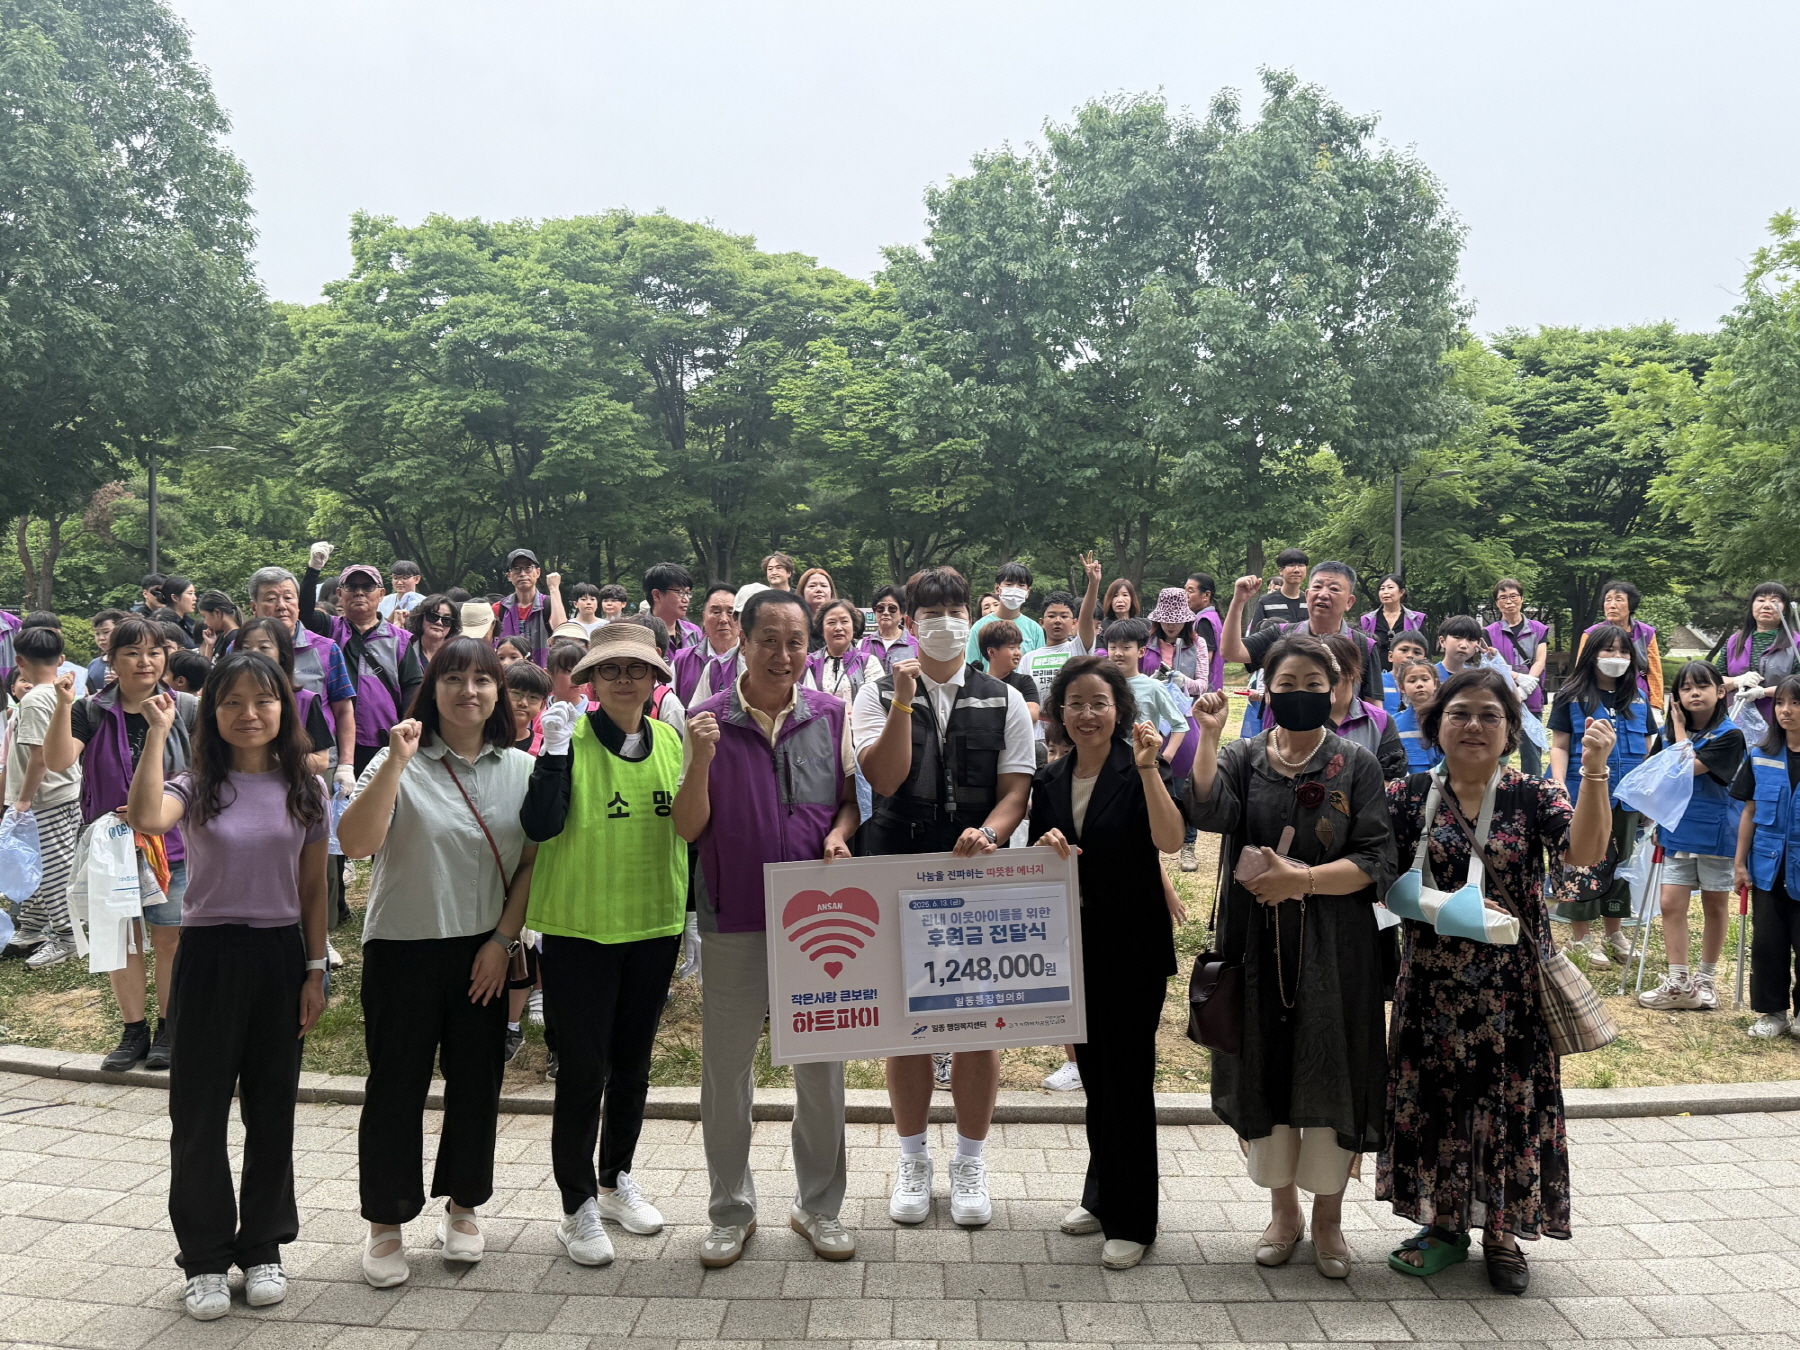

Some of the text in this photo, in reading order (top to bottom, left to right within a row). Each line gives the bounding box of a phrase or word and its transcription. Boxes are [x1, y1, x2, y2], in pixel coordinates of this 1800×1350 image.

[916, 864, 1044, 882] 나눔을 전파하는 따뜻한 에너지
[817, 902, 843, 912] ANSAN
[921, 907, 1051, 926] 관내 이웃아이들을 위한
[927, 922, 1047, 947] 후원금 전달식
[791, 988, 878, 1005] 작은사랑 큰보람!
[792, 1006, 879, 1034] 하트파이
[931, 1020, 987, 1033] 일동 행정복지센터
